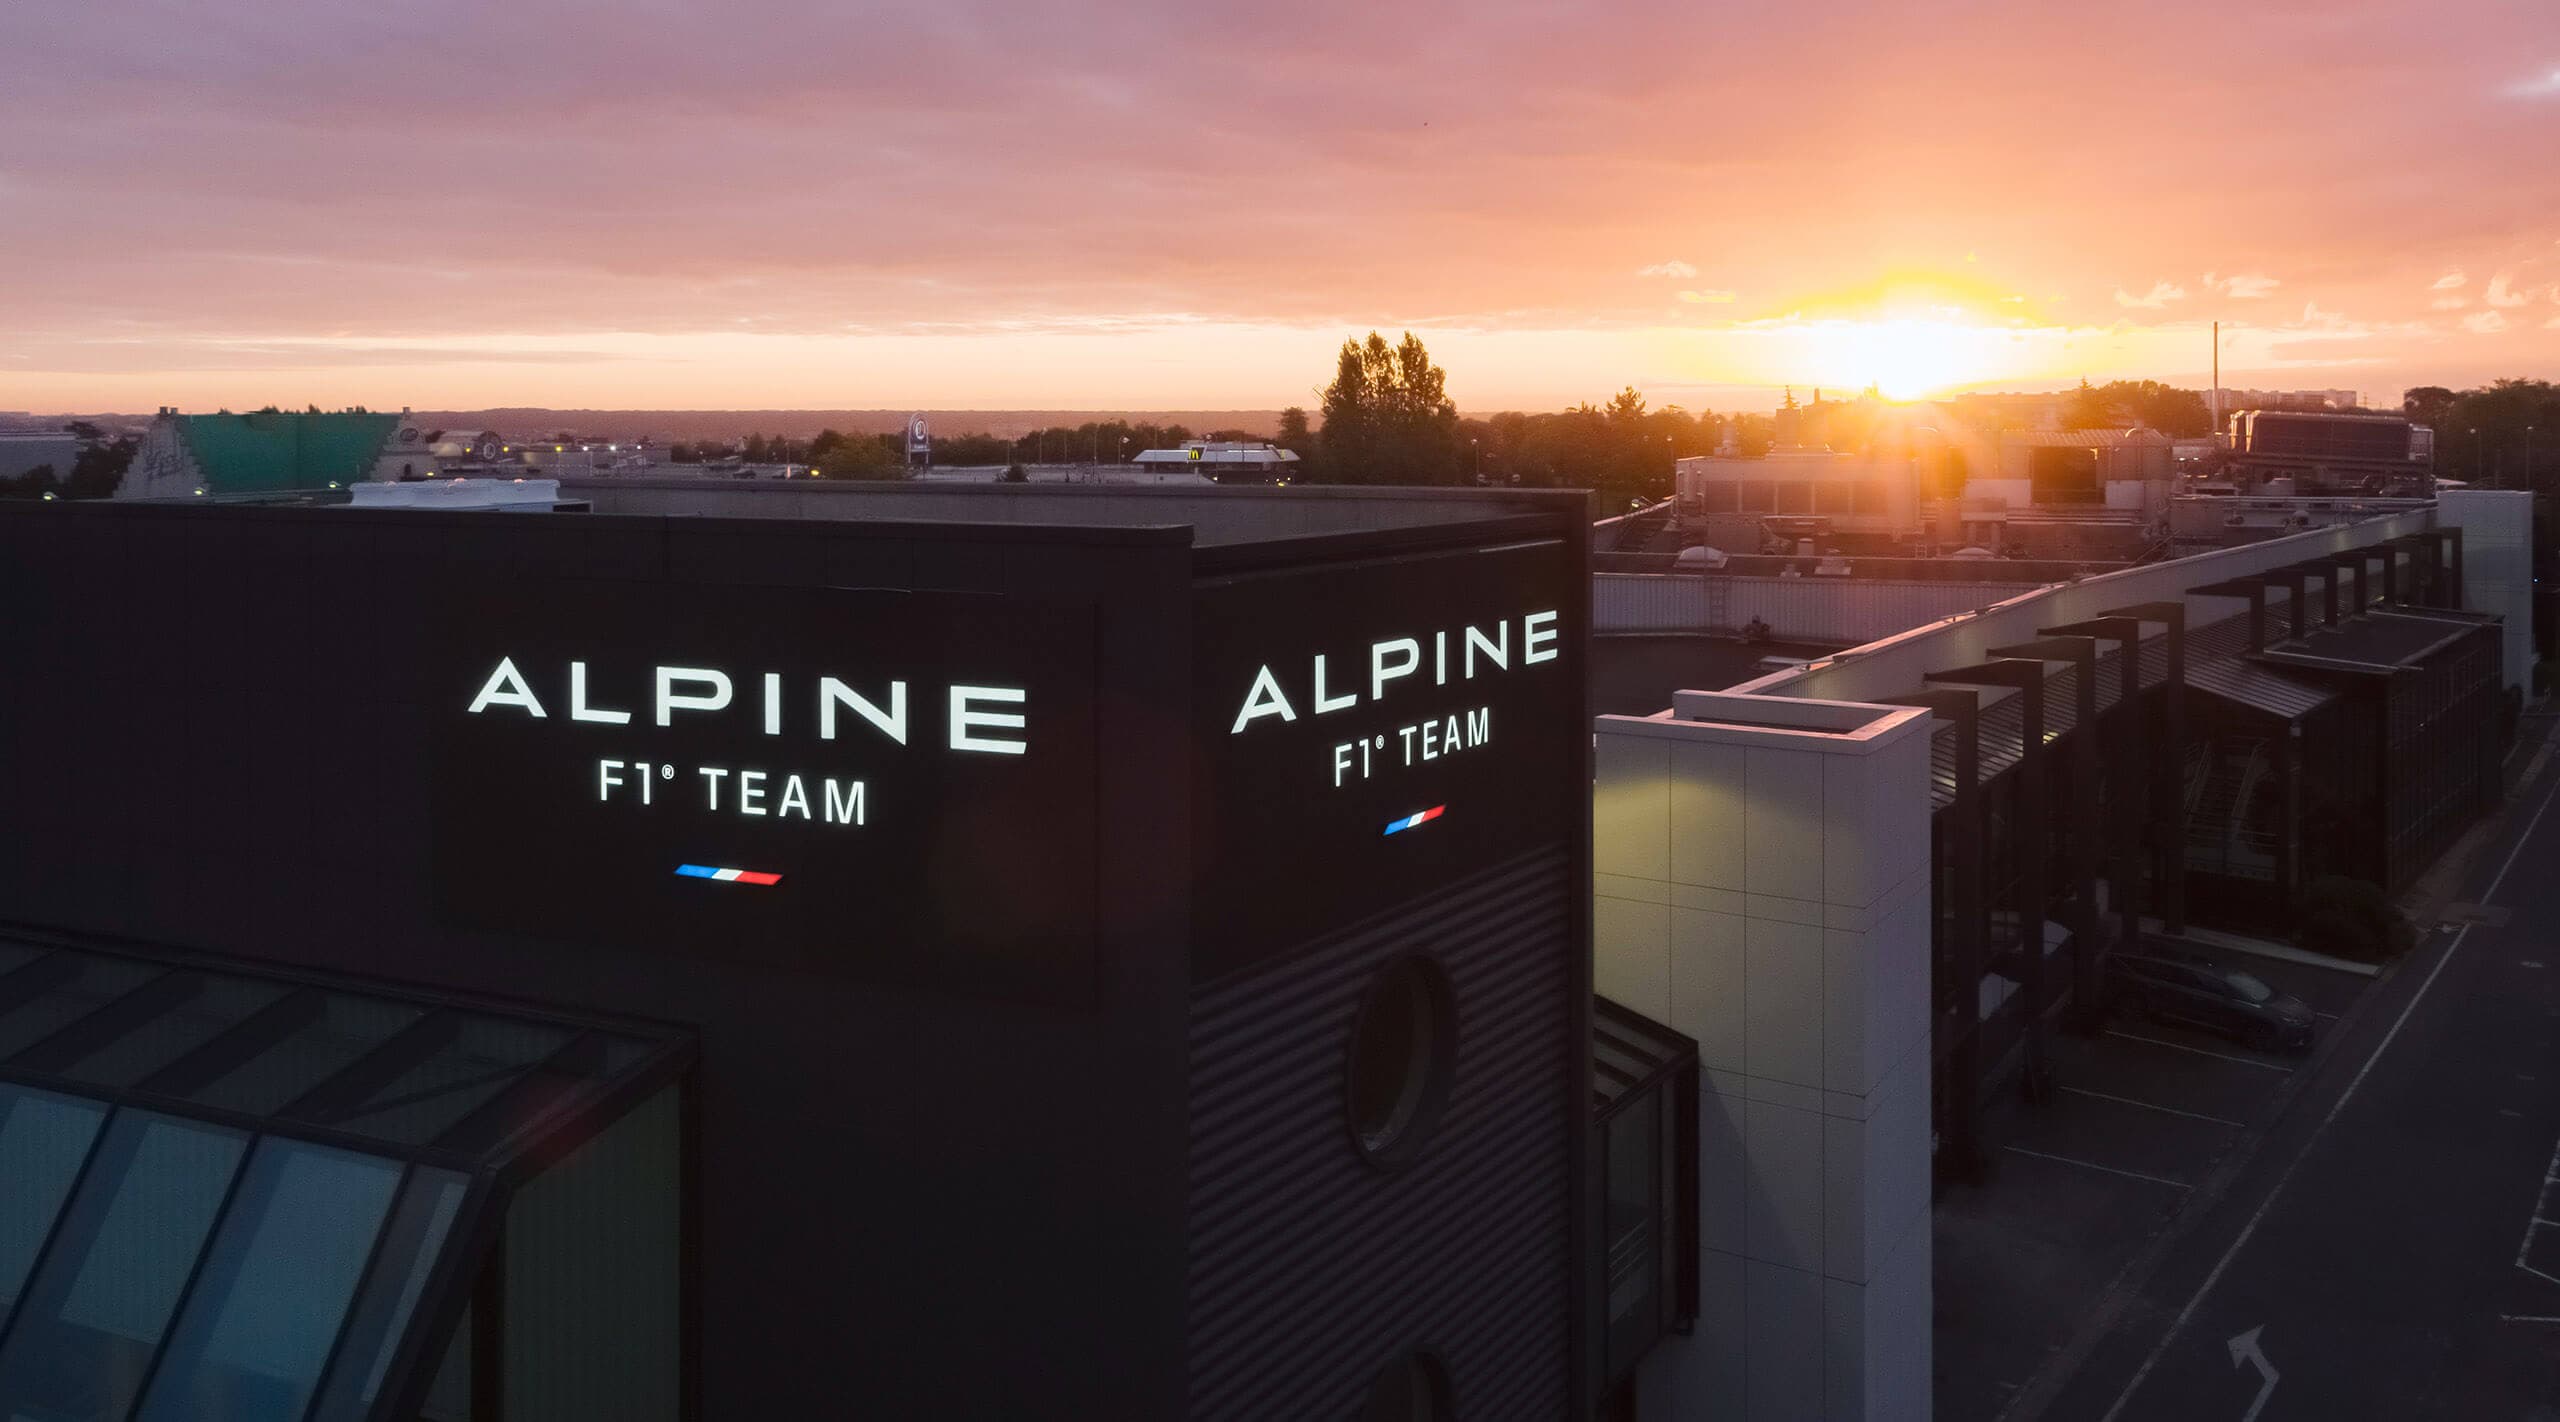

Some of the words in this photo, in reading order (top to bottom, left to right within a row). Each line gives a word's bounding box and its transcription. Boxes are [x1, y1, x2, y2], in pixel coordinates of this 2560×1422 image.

[467, 655, 1027, 755] ALPINE
[1230, 610, 1558, 734] ALPINE
[1398, 706, 1489, 767] TEAM
[698, 767, 865, 826] TEAM
